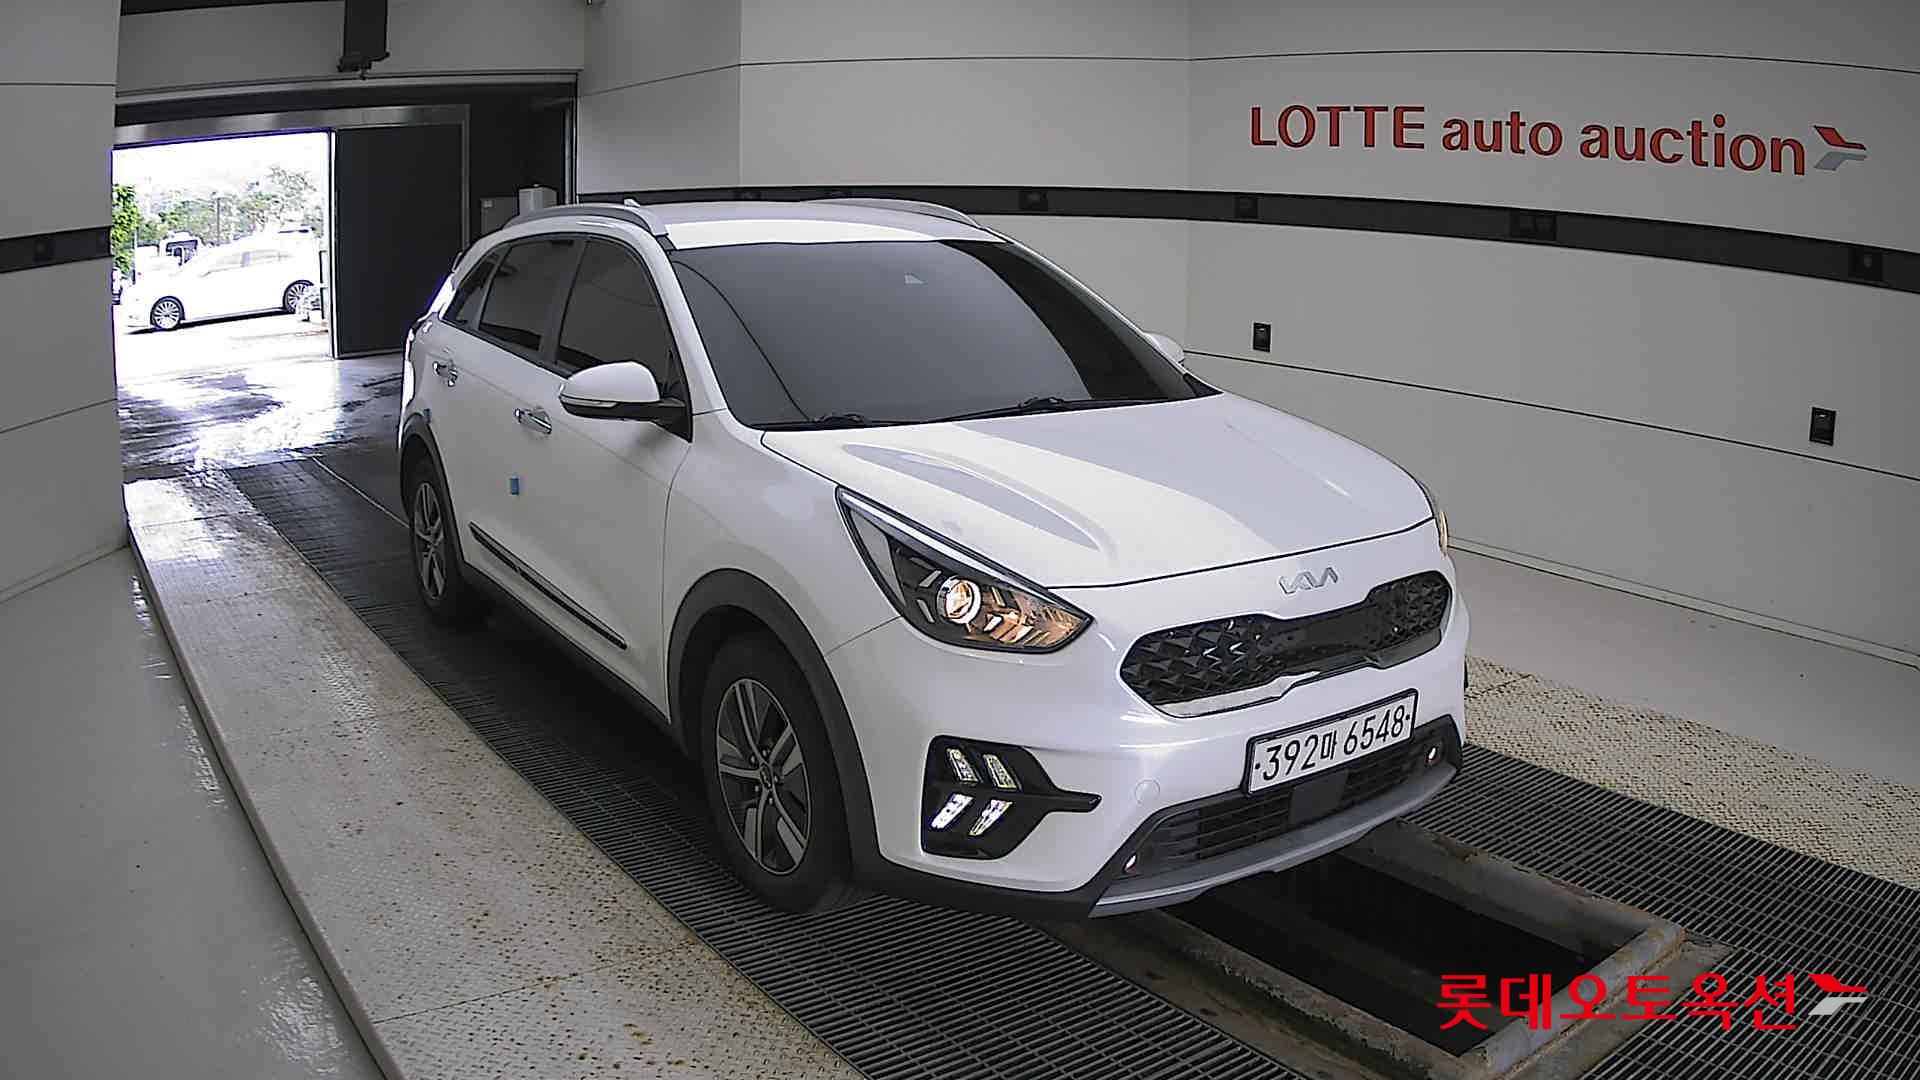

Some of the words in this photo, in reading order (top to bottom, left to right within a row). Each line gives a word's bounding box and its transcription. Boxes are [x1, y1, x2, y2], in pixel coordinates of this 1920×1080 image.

[1250, 104, 1425, 149] LOTTE
[1442, 111, 1563, 156] auto
[1579, 113, 1806, 176] auction
[1262, 731, 1338, 781] 392마
[1343, 704, 1406, 756] 6548
